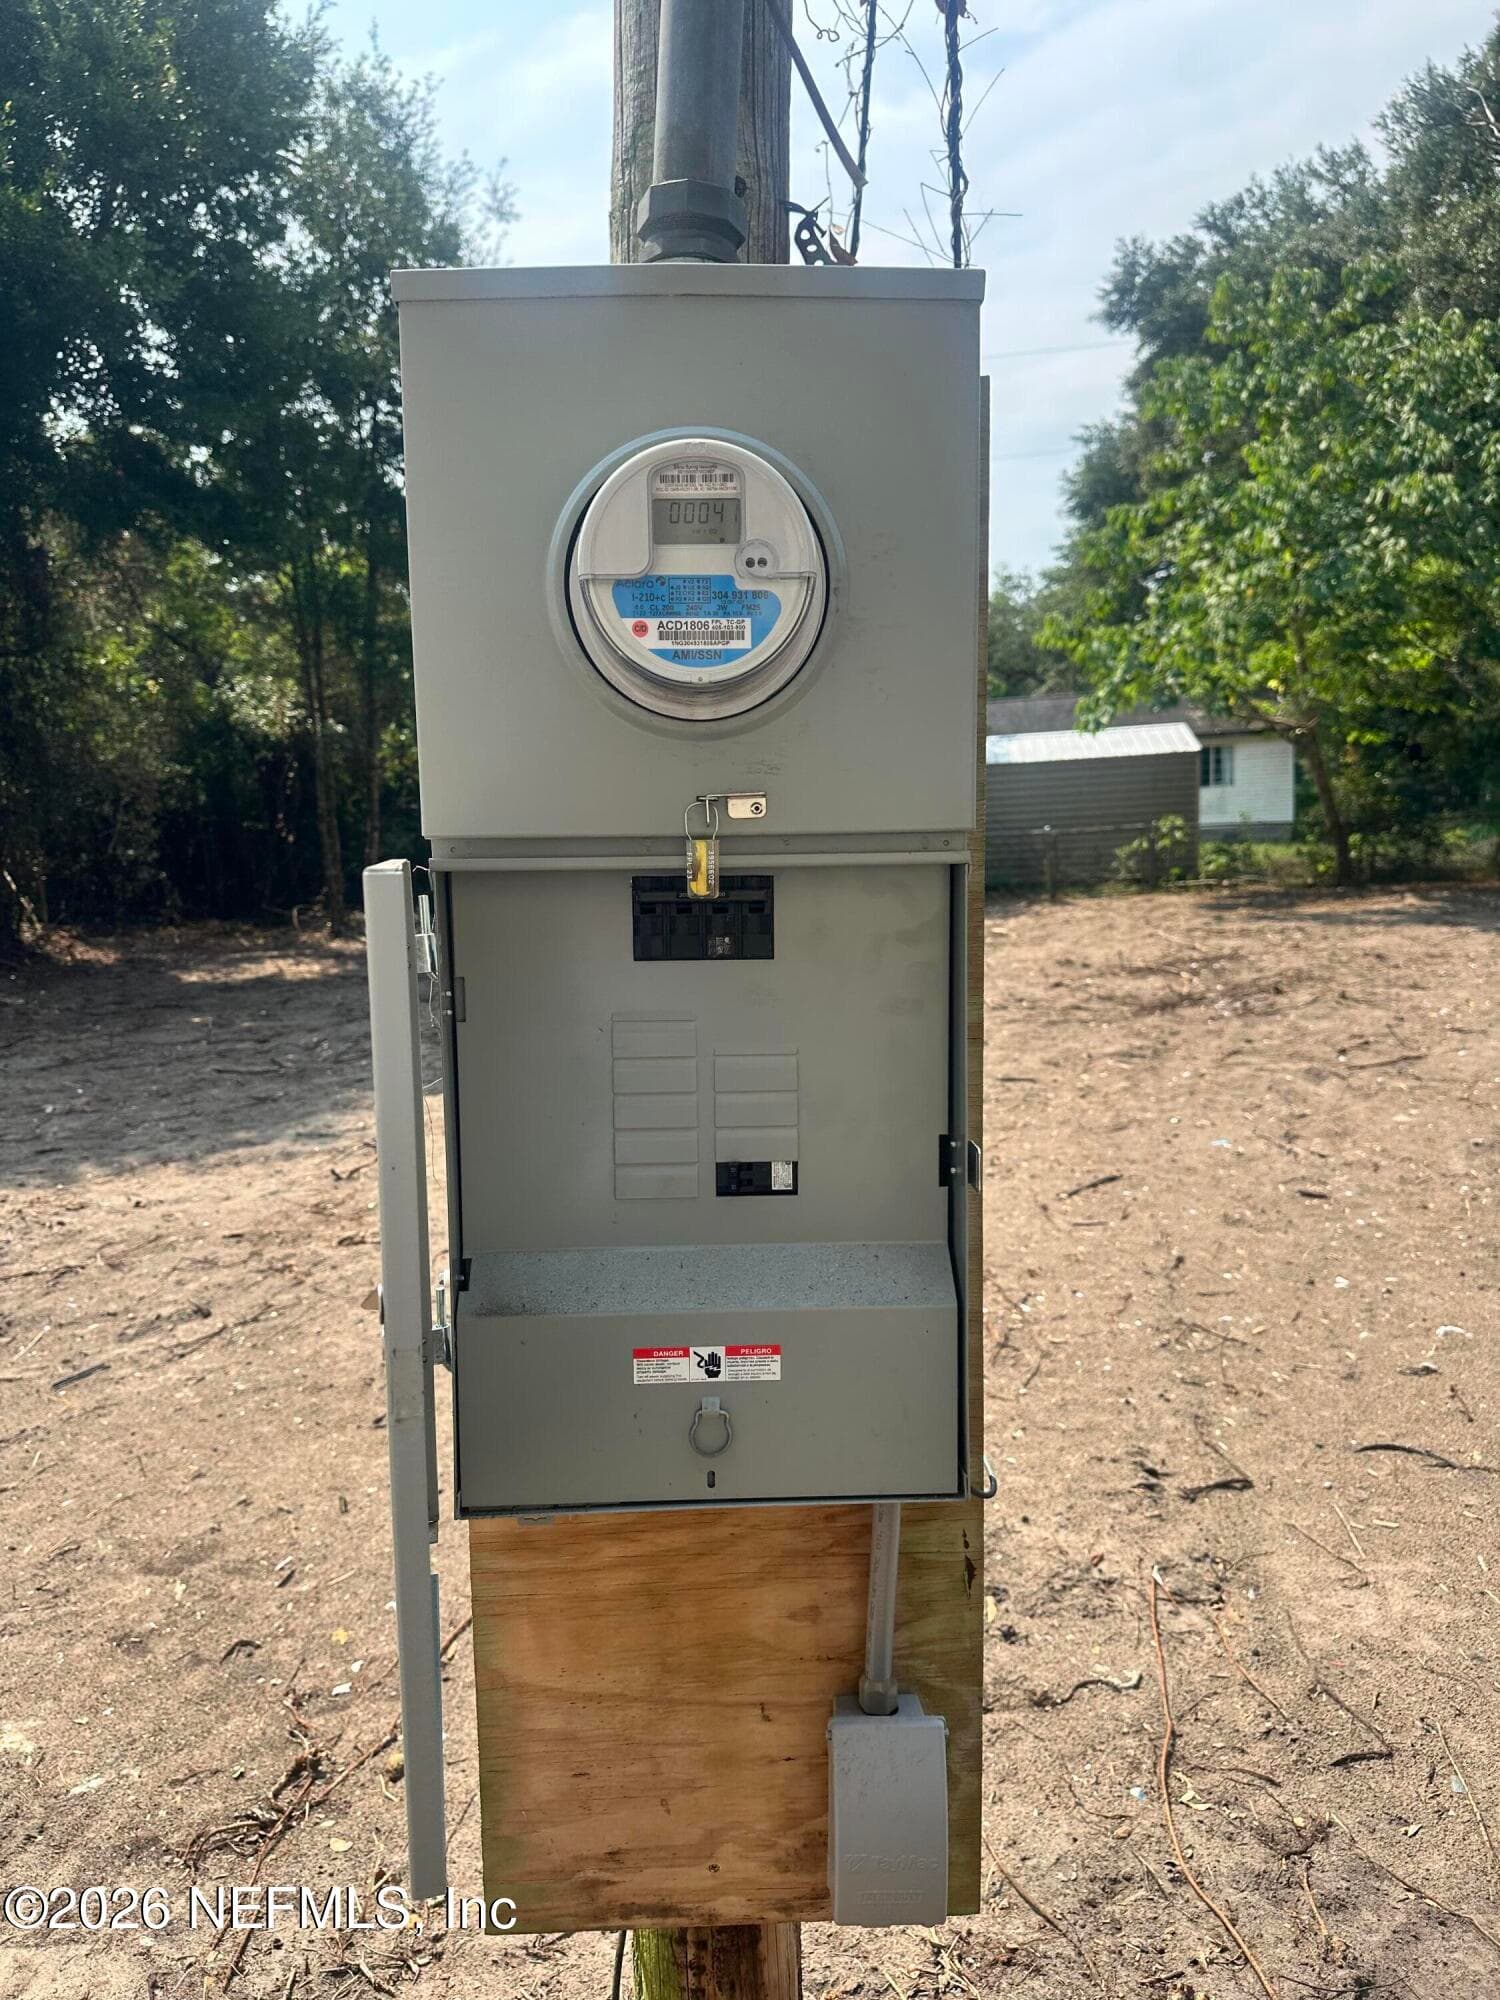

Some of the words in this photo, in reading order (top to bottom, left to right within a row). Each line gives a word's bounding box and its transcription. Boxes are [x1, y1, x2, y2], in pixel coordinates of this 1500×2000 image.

[712, 591, 729, 600] 304
[731, 591, 748, 600] 931
[657, 620, 710, 631] ACD1806
[672, 650, 722, 660] AMI/SSN
